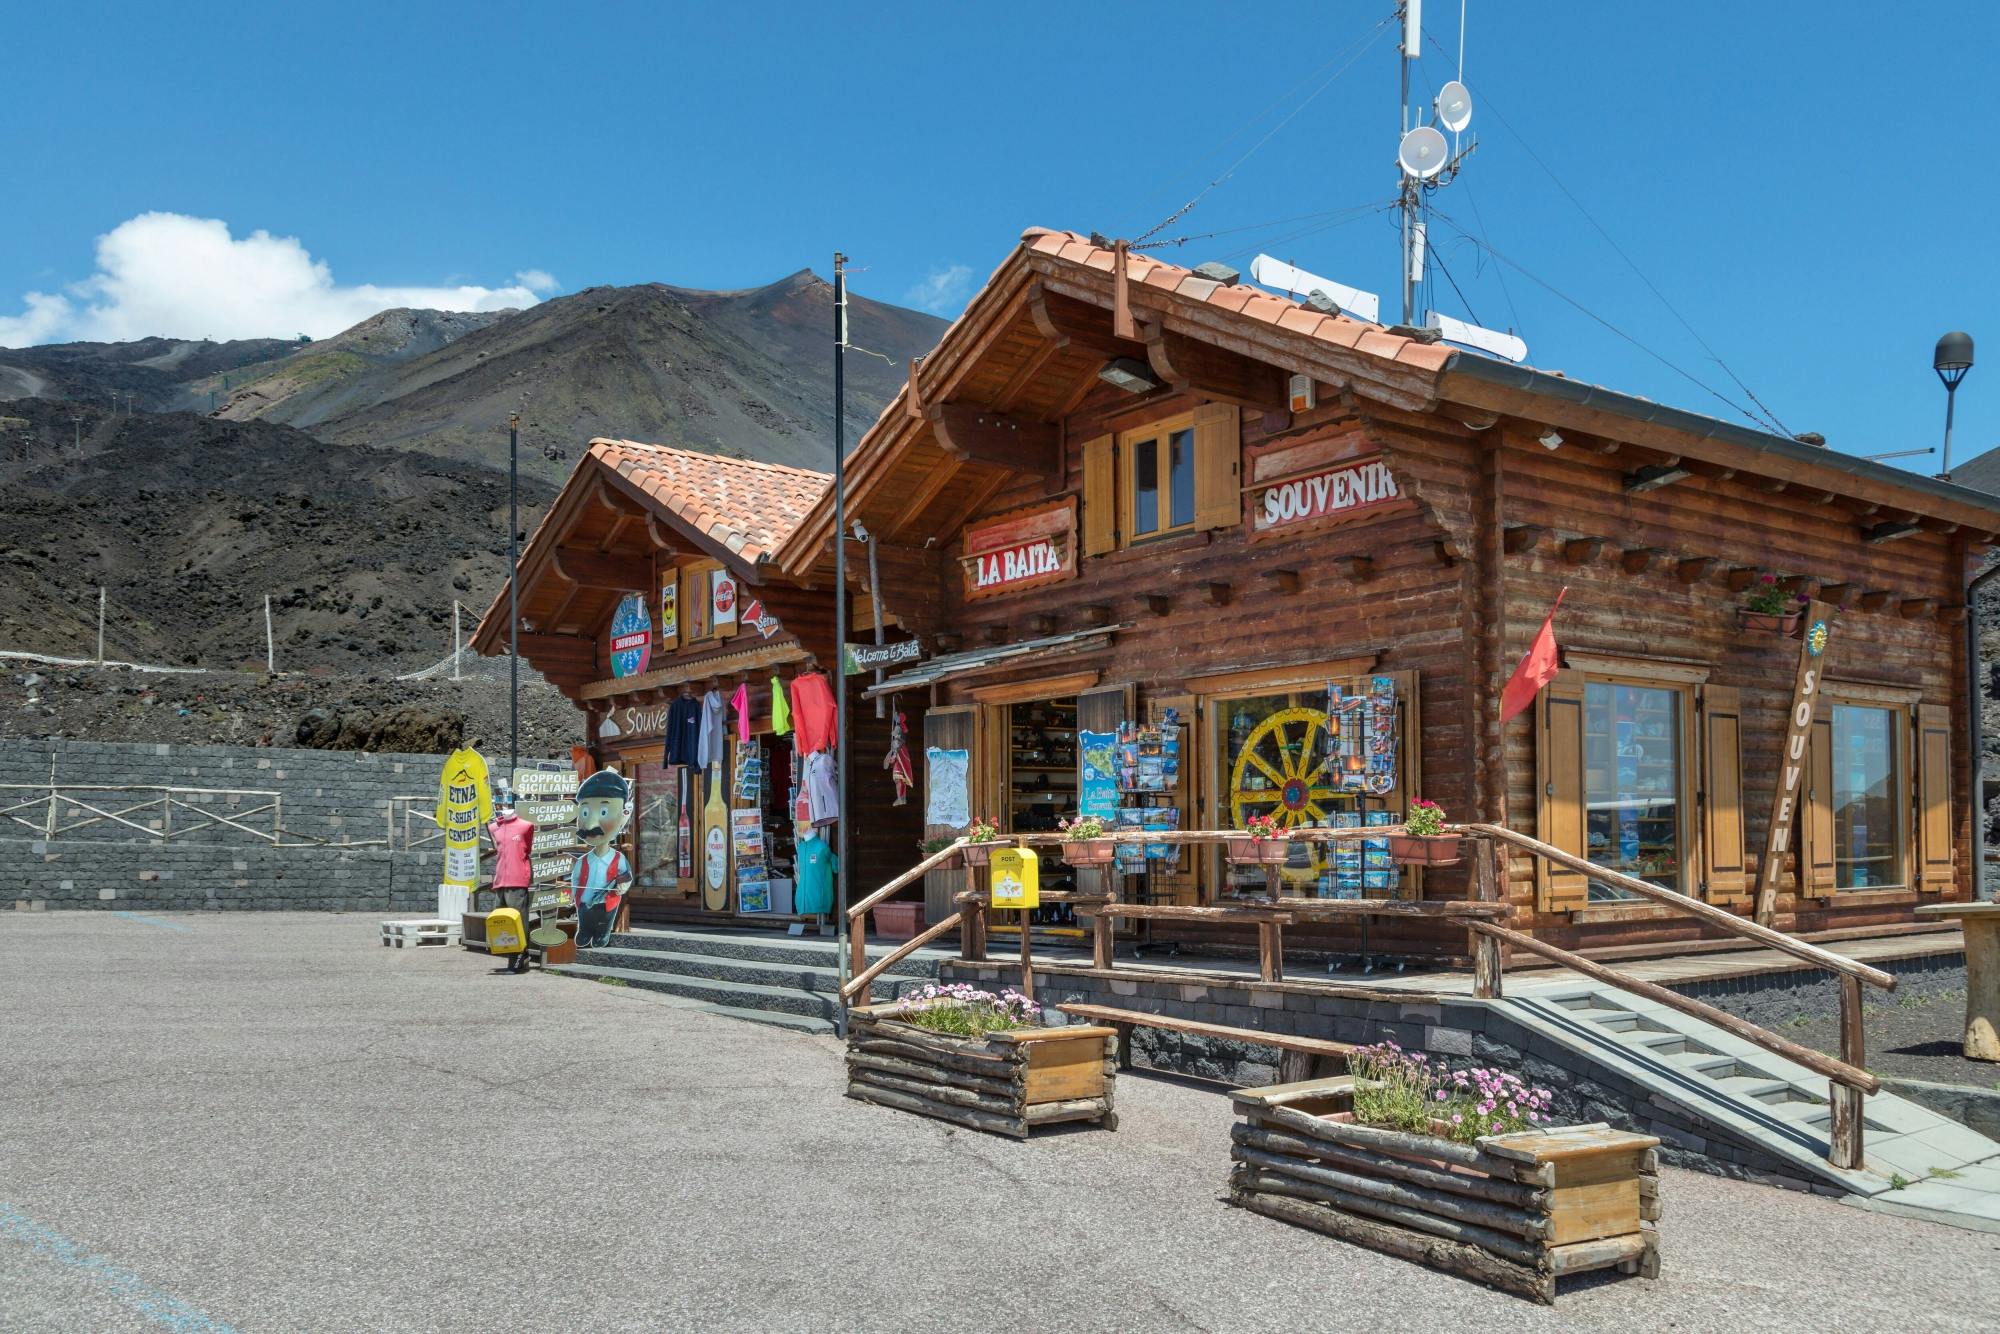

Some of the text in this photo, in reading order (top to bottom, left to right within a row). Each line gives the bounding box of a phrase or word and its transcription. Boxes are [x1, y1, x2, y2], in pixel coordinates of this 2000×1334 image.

[1264, 461, 1397, 524] SOUVENIR
[977, 542, 1060, 587] LA BAITA
[615, 633, 646, 650] SNOWBOARD
[849, 648, 889, 665] Welcome
[626, 706, 668, 735] Souve
[521, 774, 577, 783] COPPOLE
[449, 783, 477, 804] ETNA
[518, 783, 578, 793] SICILIANE
[1762, 670, 1816, 913] SOUVENIR
[448, 807, 477, 824] T-SHIRT
[528, 804, 574, 815] SICILIAN
[536, 813, 565, 823] CAPS
[448, 826, 477, 842] CENTER
[533, 831, 571, 844] HAPEAU
[532, 838, 575, 850] CILIENNE
[533, 858, 573, 872] SICILIAN
[533, 865, 571, 878] KAPPEN
[537, 894, 556, 903] MADE
